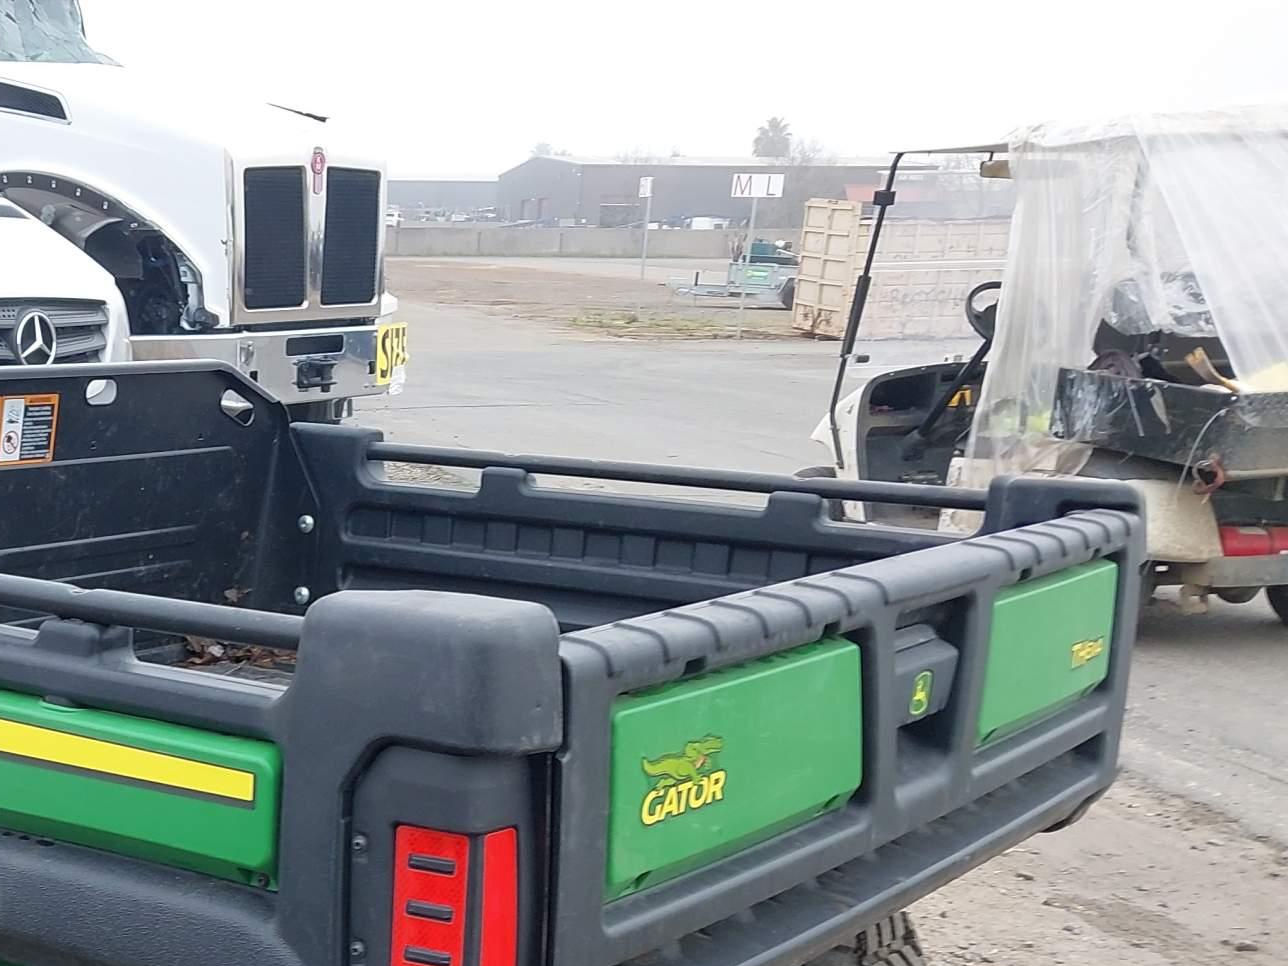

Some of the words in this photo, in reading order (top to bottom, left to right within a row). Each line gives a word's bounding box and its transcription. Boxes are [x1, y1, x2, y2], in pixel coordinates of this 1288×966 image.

[733, 175, 753, 196] M
[766, 175, 777, 196] L
[640, 769, 727, 826] GATOR
